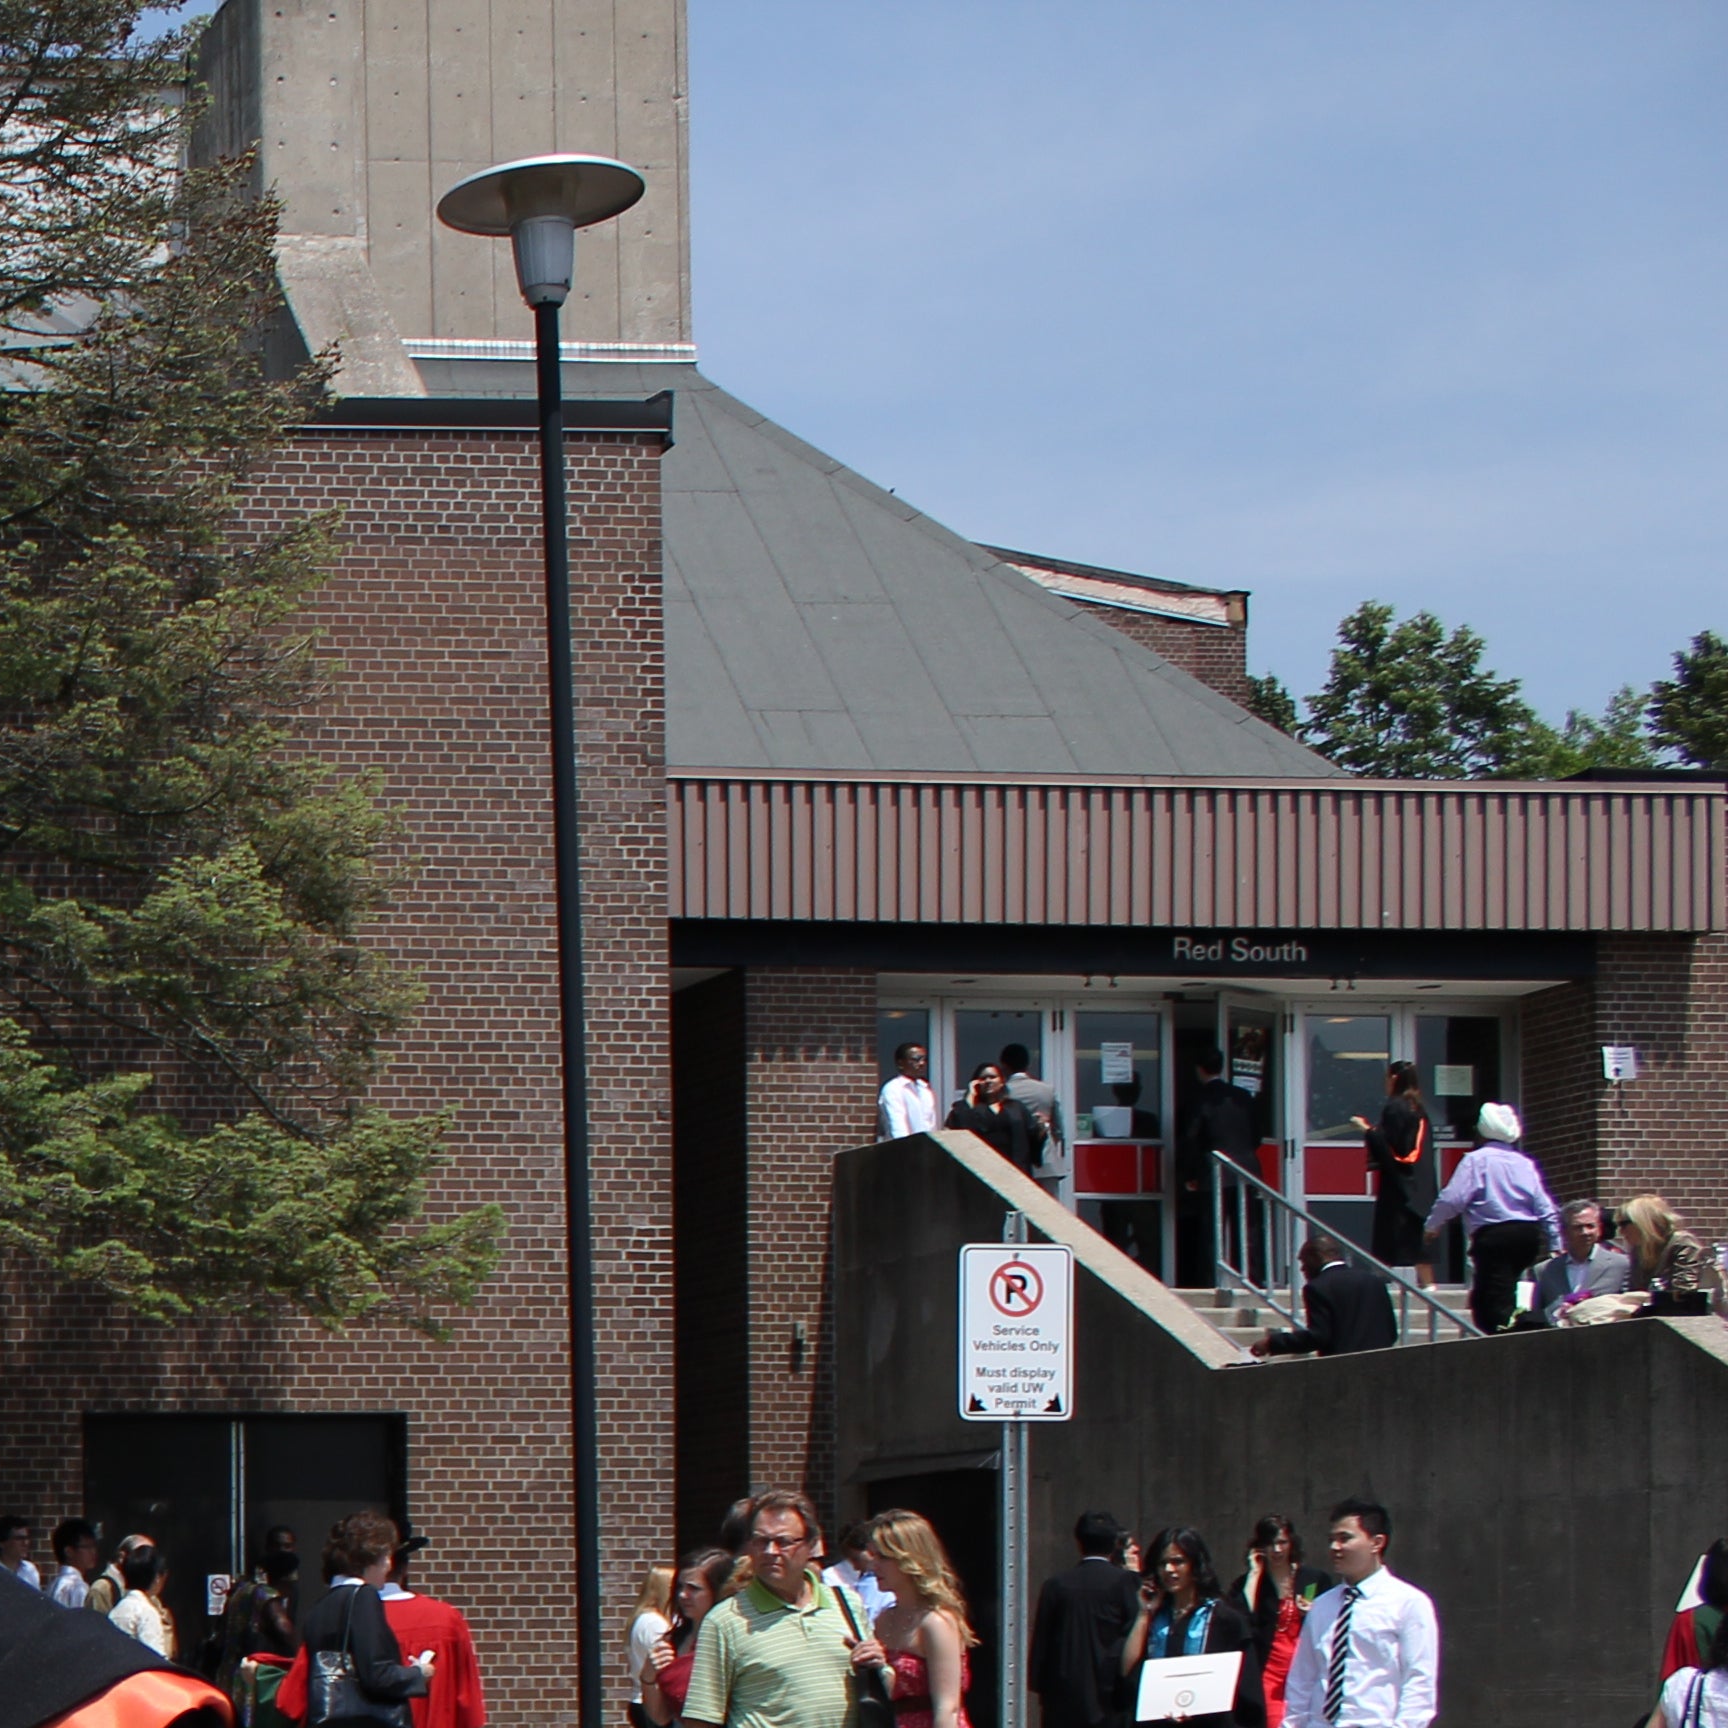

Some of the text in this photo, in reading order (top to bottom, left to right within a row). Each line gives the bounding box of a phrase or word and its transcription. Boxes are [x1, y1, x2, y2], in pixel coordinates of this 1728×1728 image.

[1173, 936, 1307, 962] Red South
[992, 1325, 1039, 1336] Service
[973, 1340, 1059, 1354] Vehicles Only
[975, 1366, 1056, 1380] Must display
[988, 1382, 1044, 1393] valid UW
[995, 1398, 1037, 1409] Permit
